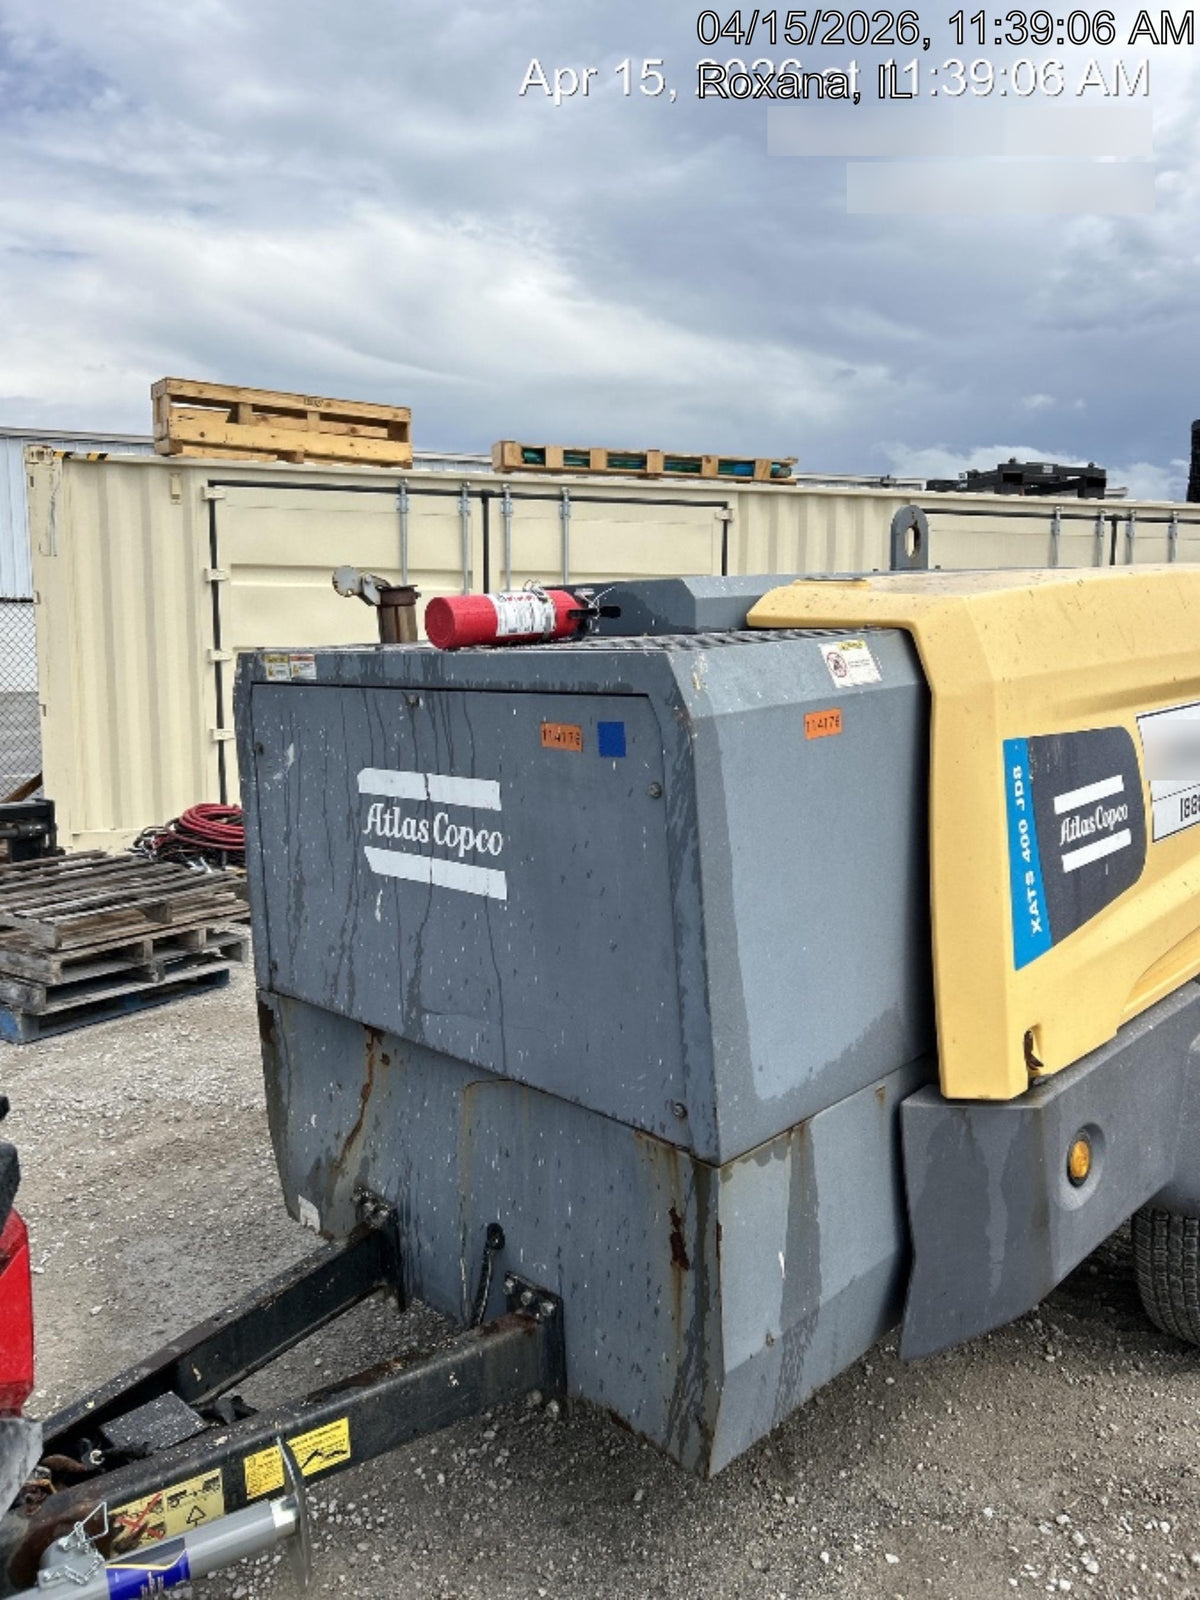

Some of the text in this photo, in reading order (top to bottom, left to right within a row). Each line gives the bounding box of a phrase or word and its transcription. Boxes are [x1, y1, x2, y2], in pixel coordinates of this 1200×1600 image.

[362, 802, 504, 858] Atlas Copco
[1018, 818, 1032, 863] 400
[1059, 803, 1129, 847] Atlas Copco
[1024, 870, 1043, 936] XATS
